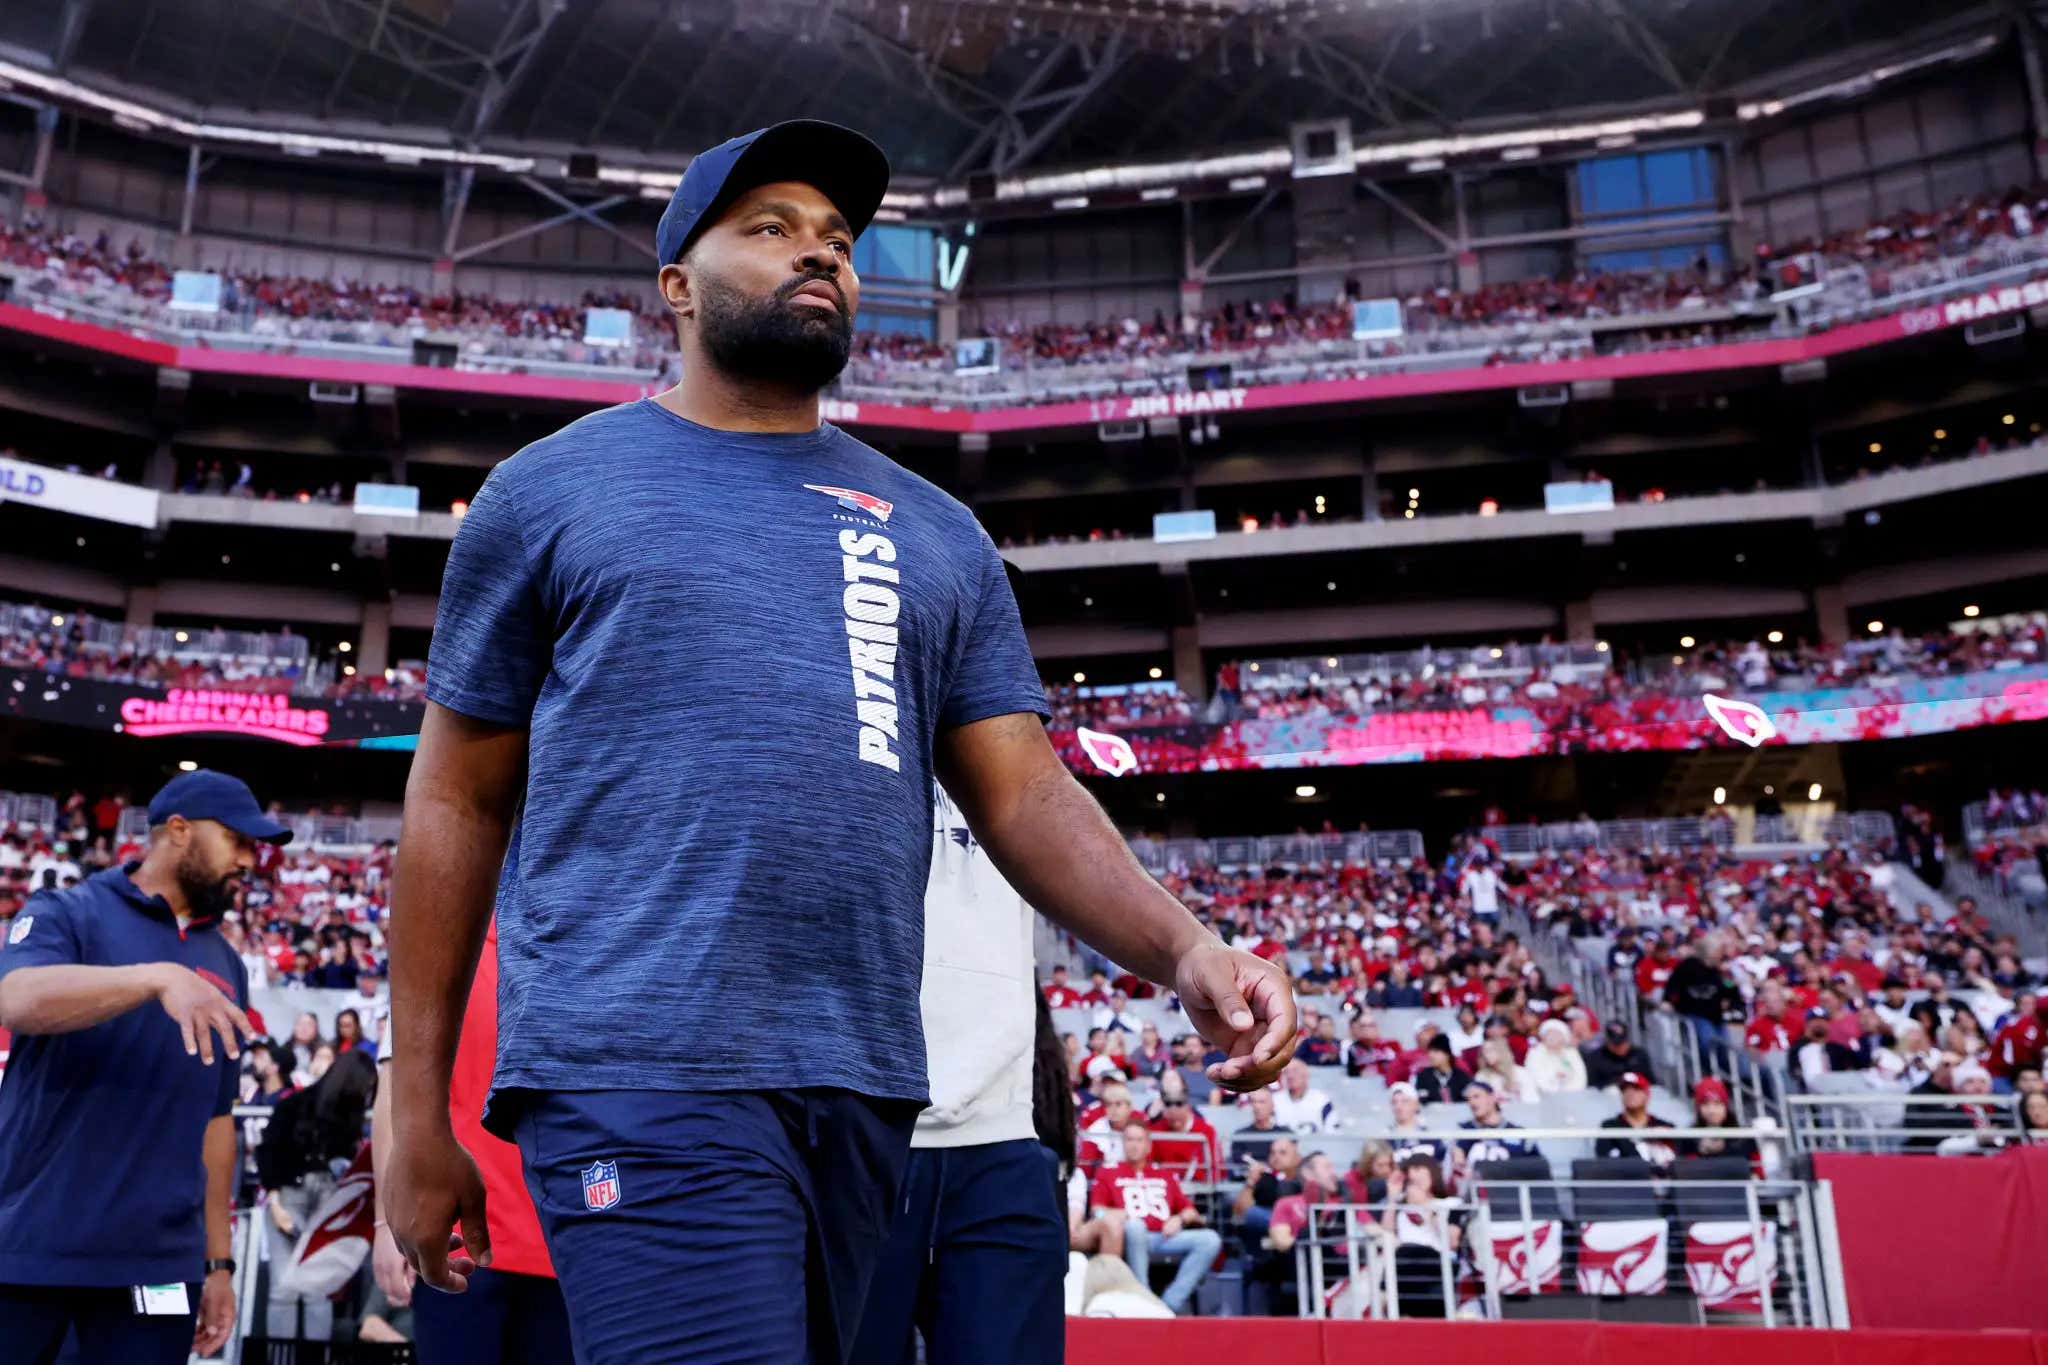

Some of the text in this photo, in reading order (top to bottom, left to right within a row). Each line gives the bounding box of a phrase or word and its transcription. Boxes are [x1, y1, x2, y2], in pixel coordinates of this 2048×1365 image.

[1945, 280, 2048, 324] MARS
[1126, 395, 1169, 417] JIM
[1174, 388, 1247, 412] HART
[832, 513, 889, 530] FOOTBALL
[838, 529, 900, 773] PATRIOTS
[167, 688, 288, 711] CARDINALS
[121, 697, 329, 735] CHEERLEADERS
[588, 1181, 616, 1206] NFL
[1122, 1186, 1170, 1220] 85
